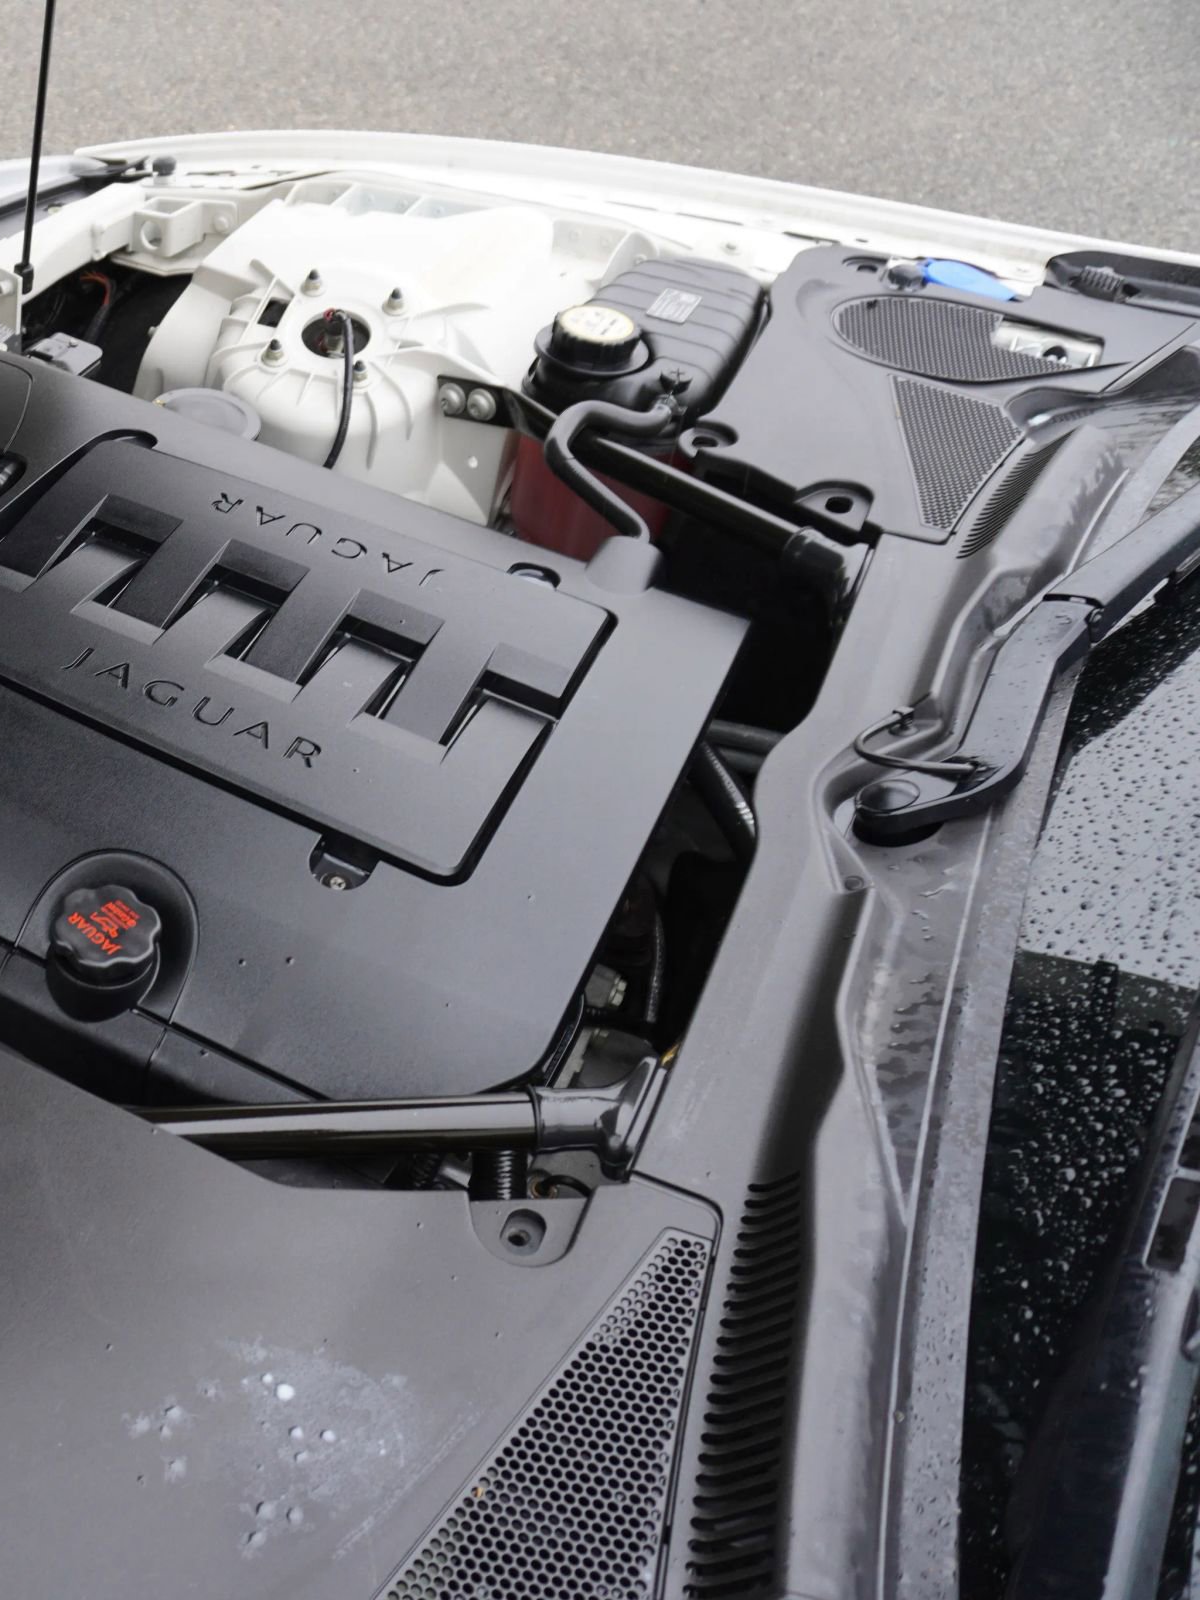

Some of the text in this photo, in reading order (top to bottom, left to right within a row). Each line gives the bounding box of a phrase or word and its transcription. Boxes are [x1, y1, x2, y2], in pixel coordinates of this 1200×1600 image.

[212, 493, 444, 586] JAGUAR
[61, 647, 322, 768] JAGUAR
[67, 912, 124, 955] JAGUAR
